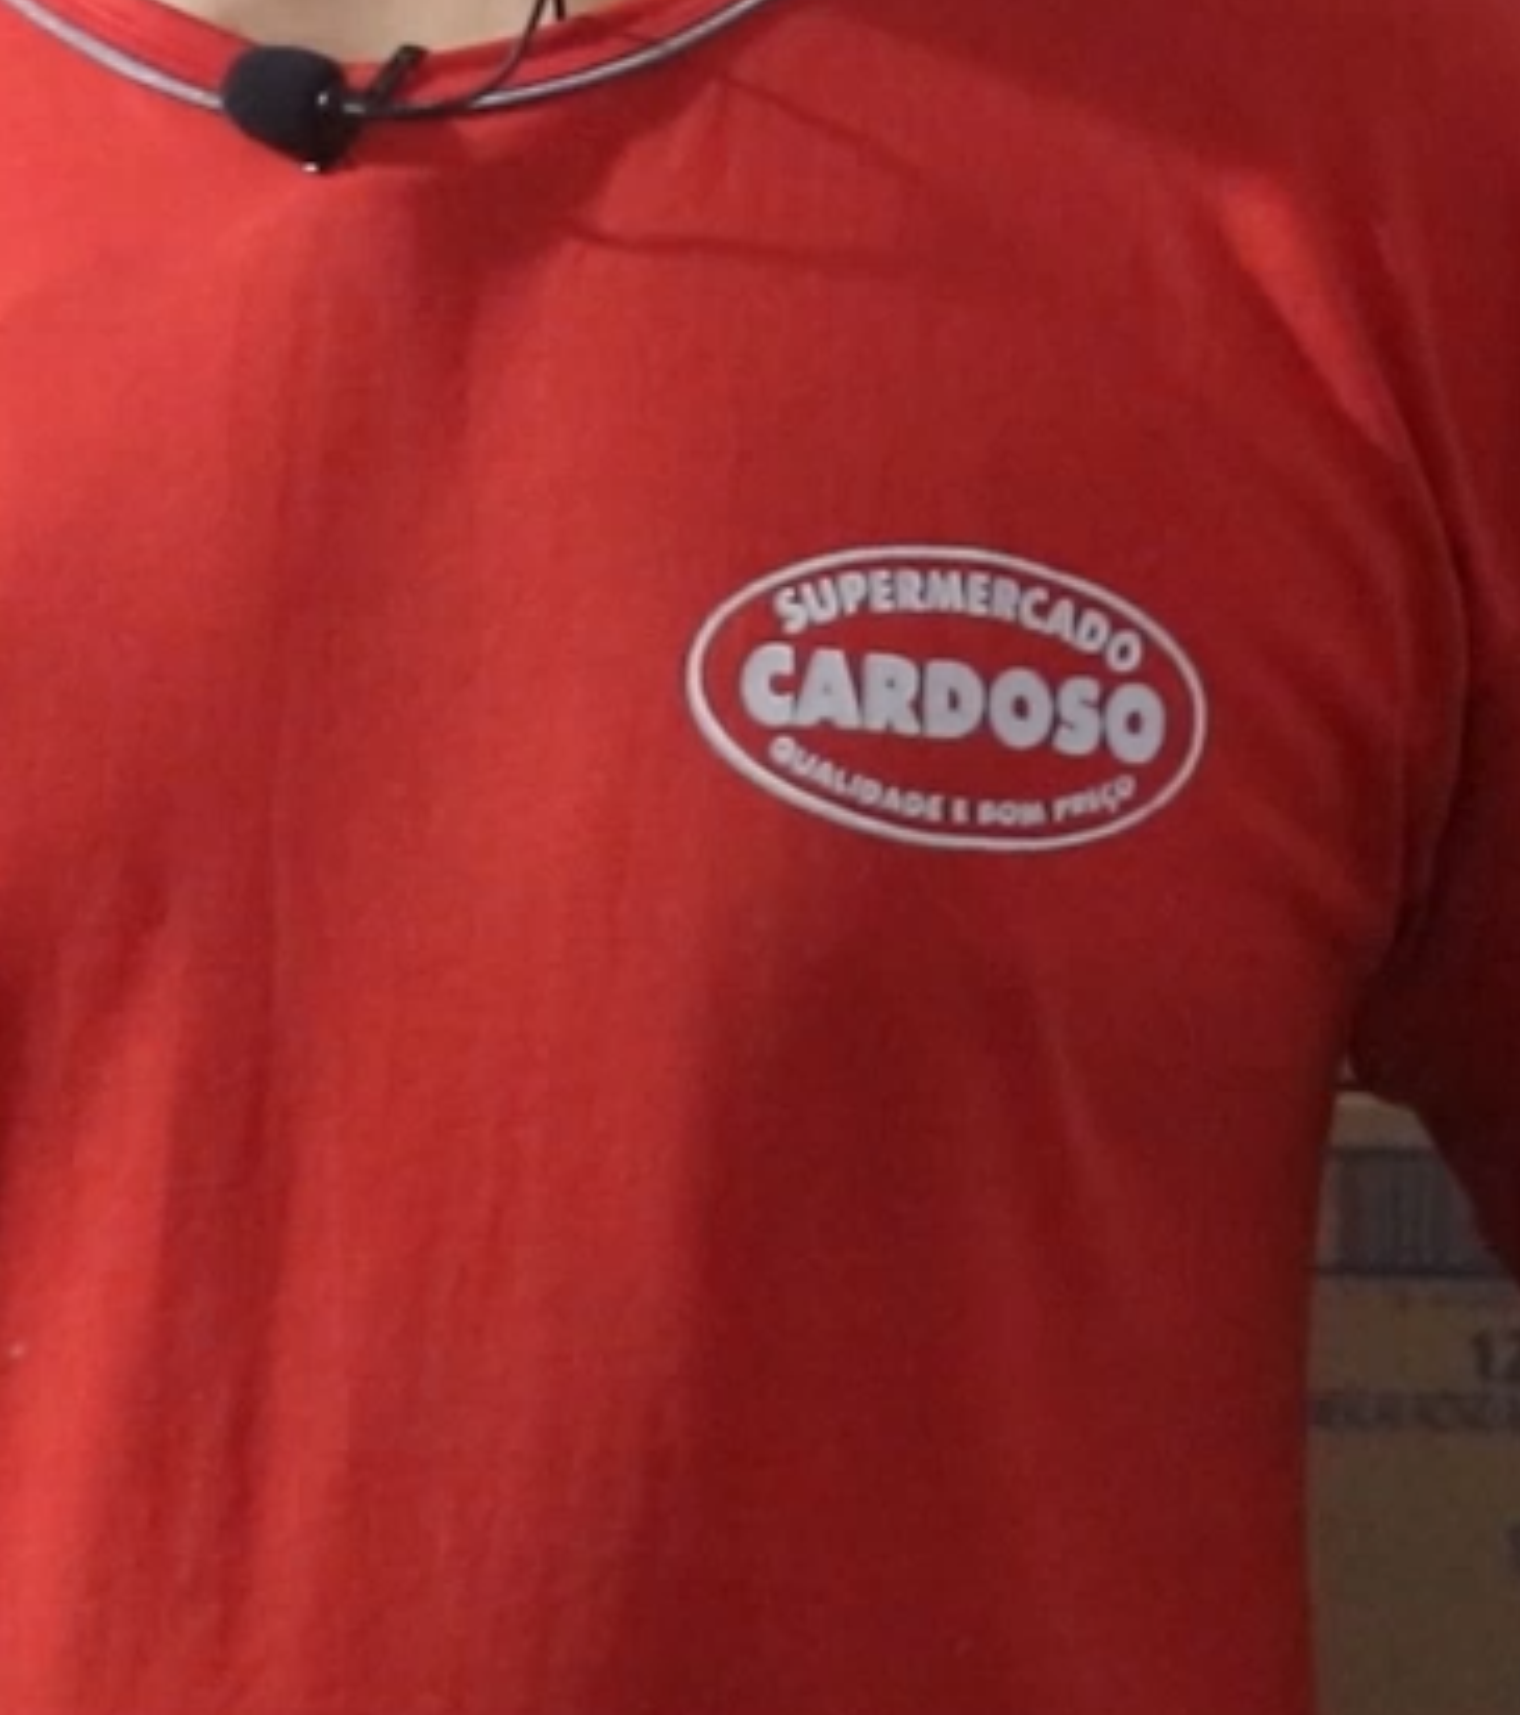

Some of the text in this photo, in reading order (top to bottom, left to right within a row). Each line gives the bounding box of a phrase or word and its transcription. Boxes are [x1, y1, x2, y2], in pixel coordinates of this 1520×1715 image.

[774, 569, 1142, 673] SUPERMERCADO
[740, 643, 1166, 764] CARDOSO
[768, 735, 943, 822] QUALIDADE
[952, 797, 968, 823] E
[977, 800, 1046, 825] BOM
